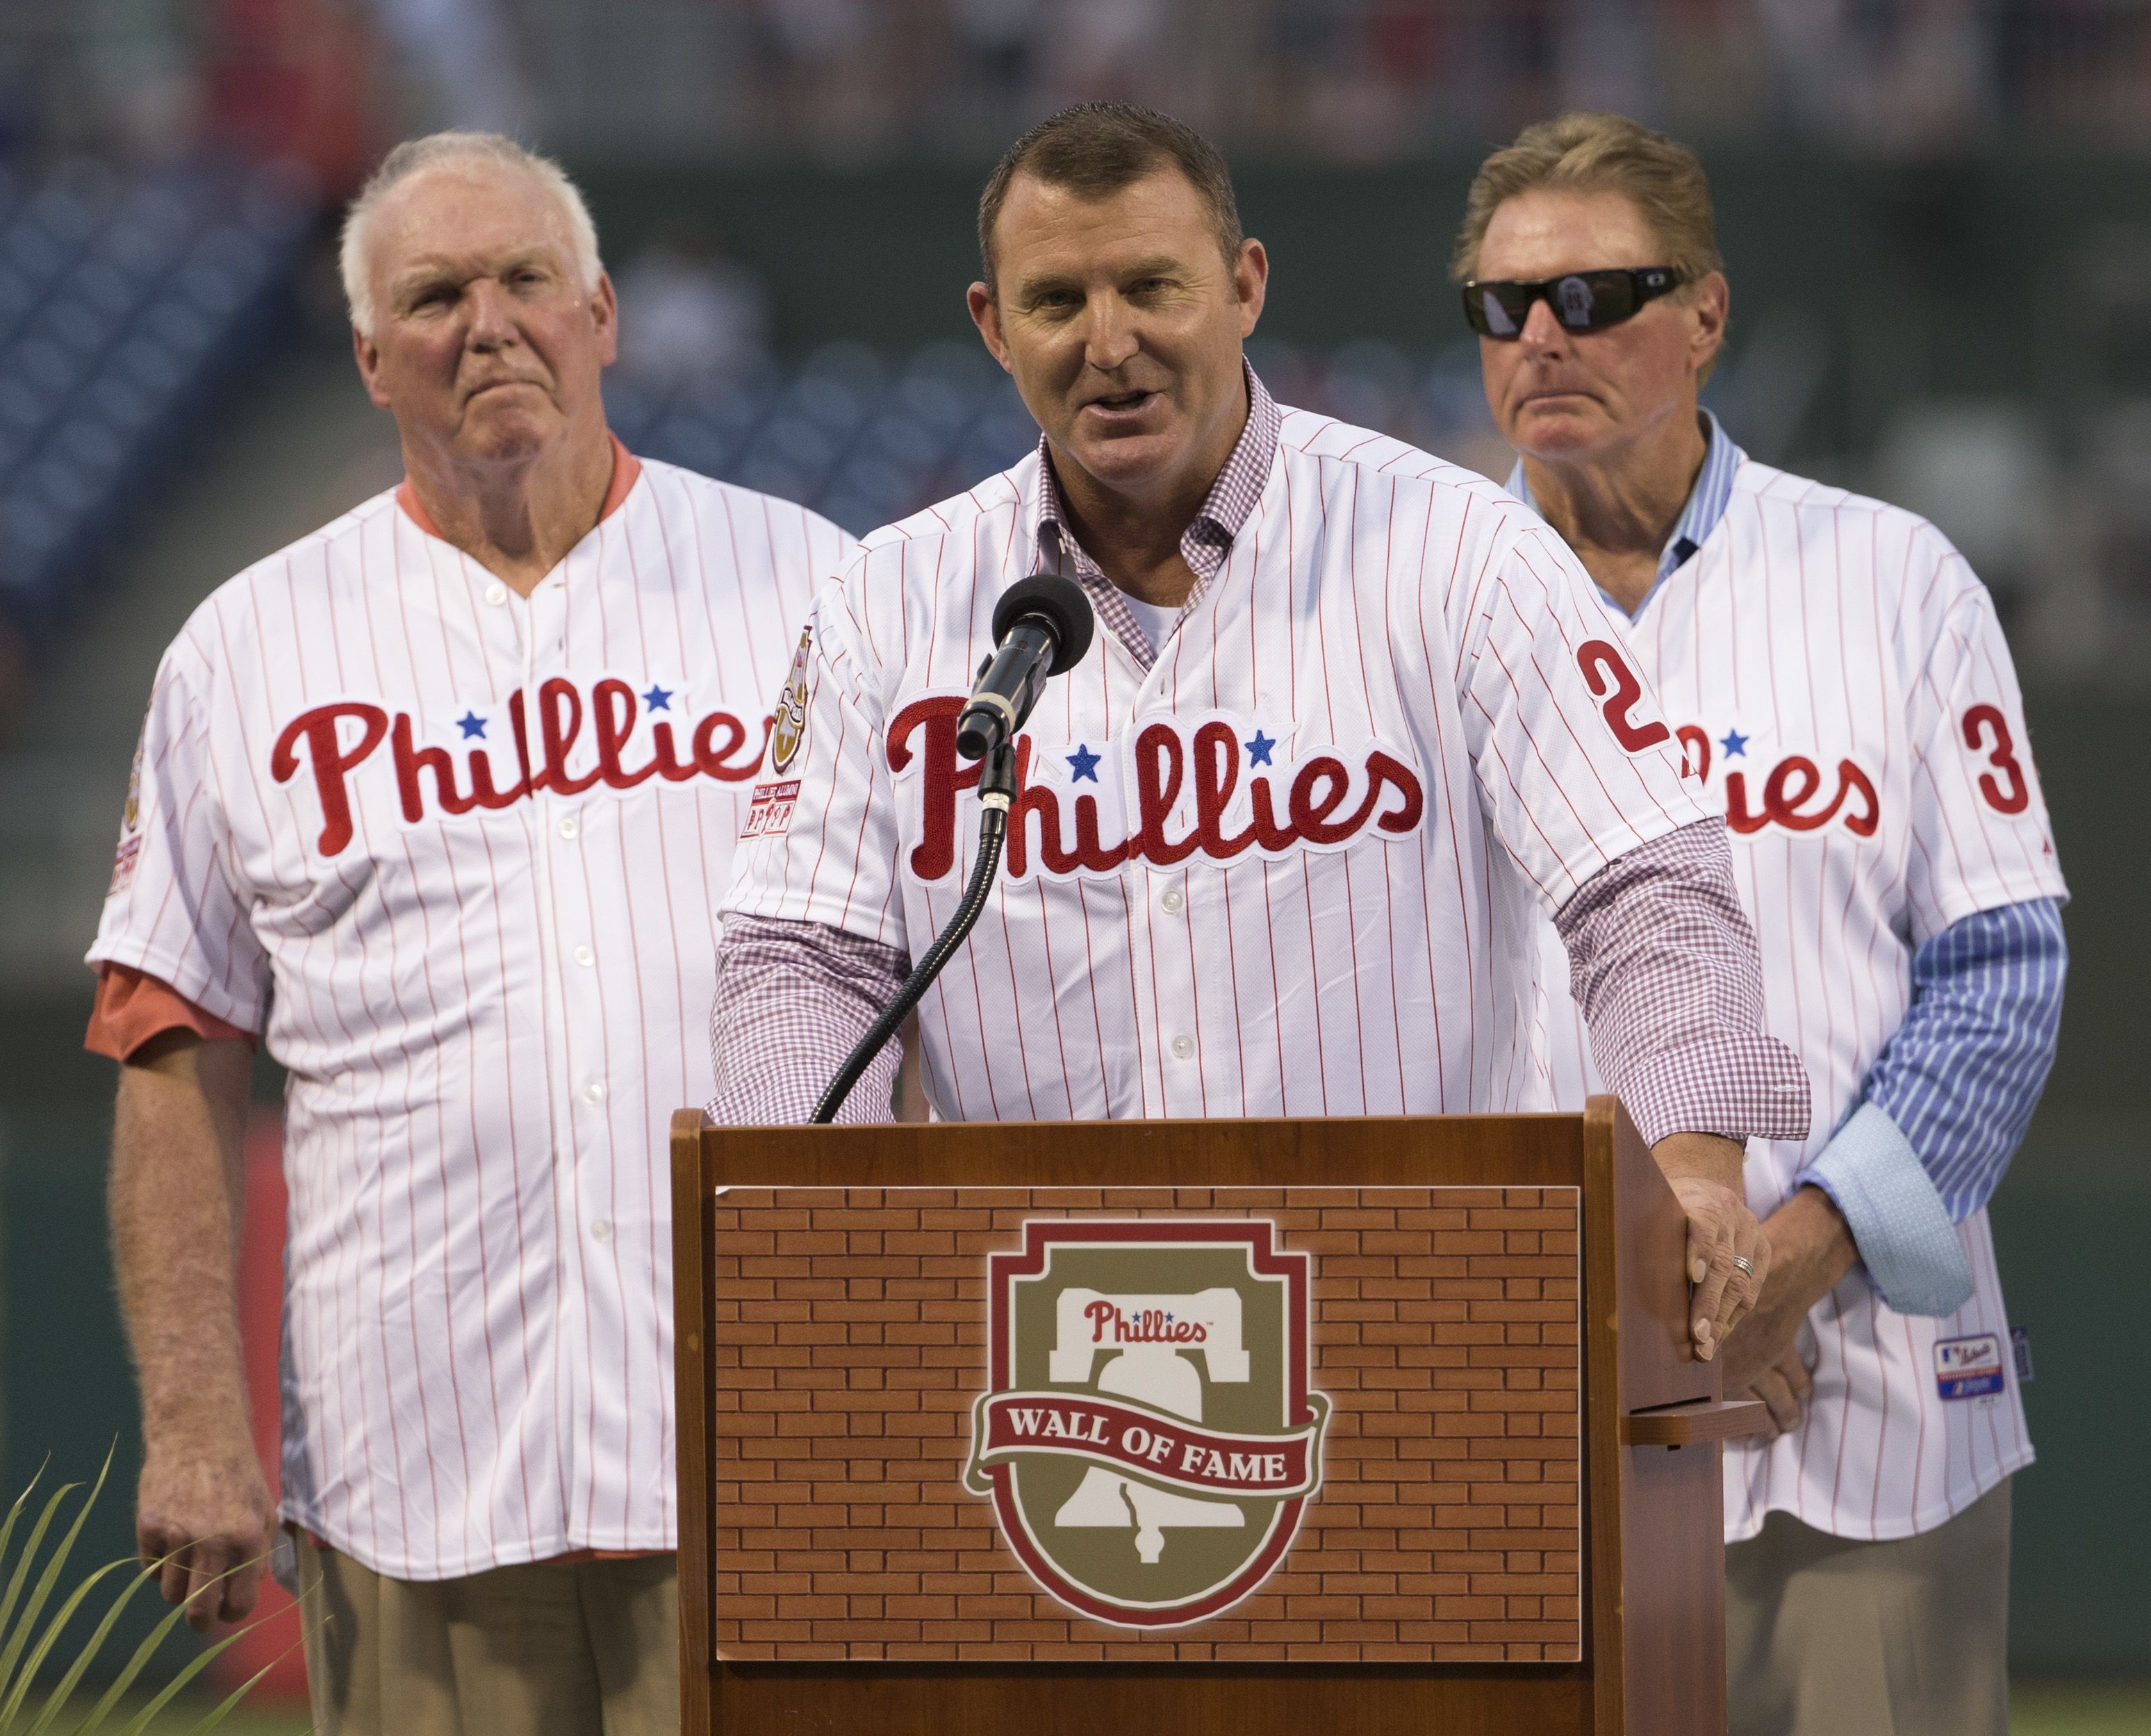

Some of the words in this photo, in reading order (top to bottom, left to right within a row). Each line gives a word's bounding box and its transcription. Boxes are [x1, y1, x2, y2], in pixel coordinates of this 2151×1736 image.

[272, 677, 770, 857] Phillie
[753, 786, 777, 801] PHILLIES
[776, 783, 799, 797] ALUMNI
[887, 695, 1422, 879] Phillies
[1962, 704, 2029, 814] 3
[1084, 1300, 1207, 1343] Phillies
[1007, 1408, 1110, 1445] WALL
[1121, 1426, 1175, 1464] OF
[1179, 1444, 1288, 1482] FAME
